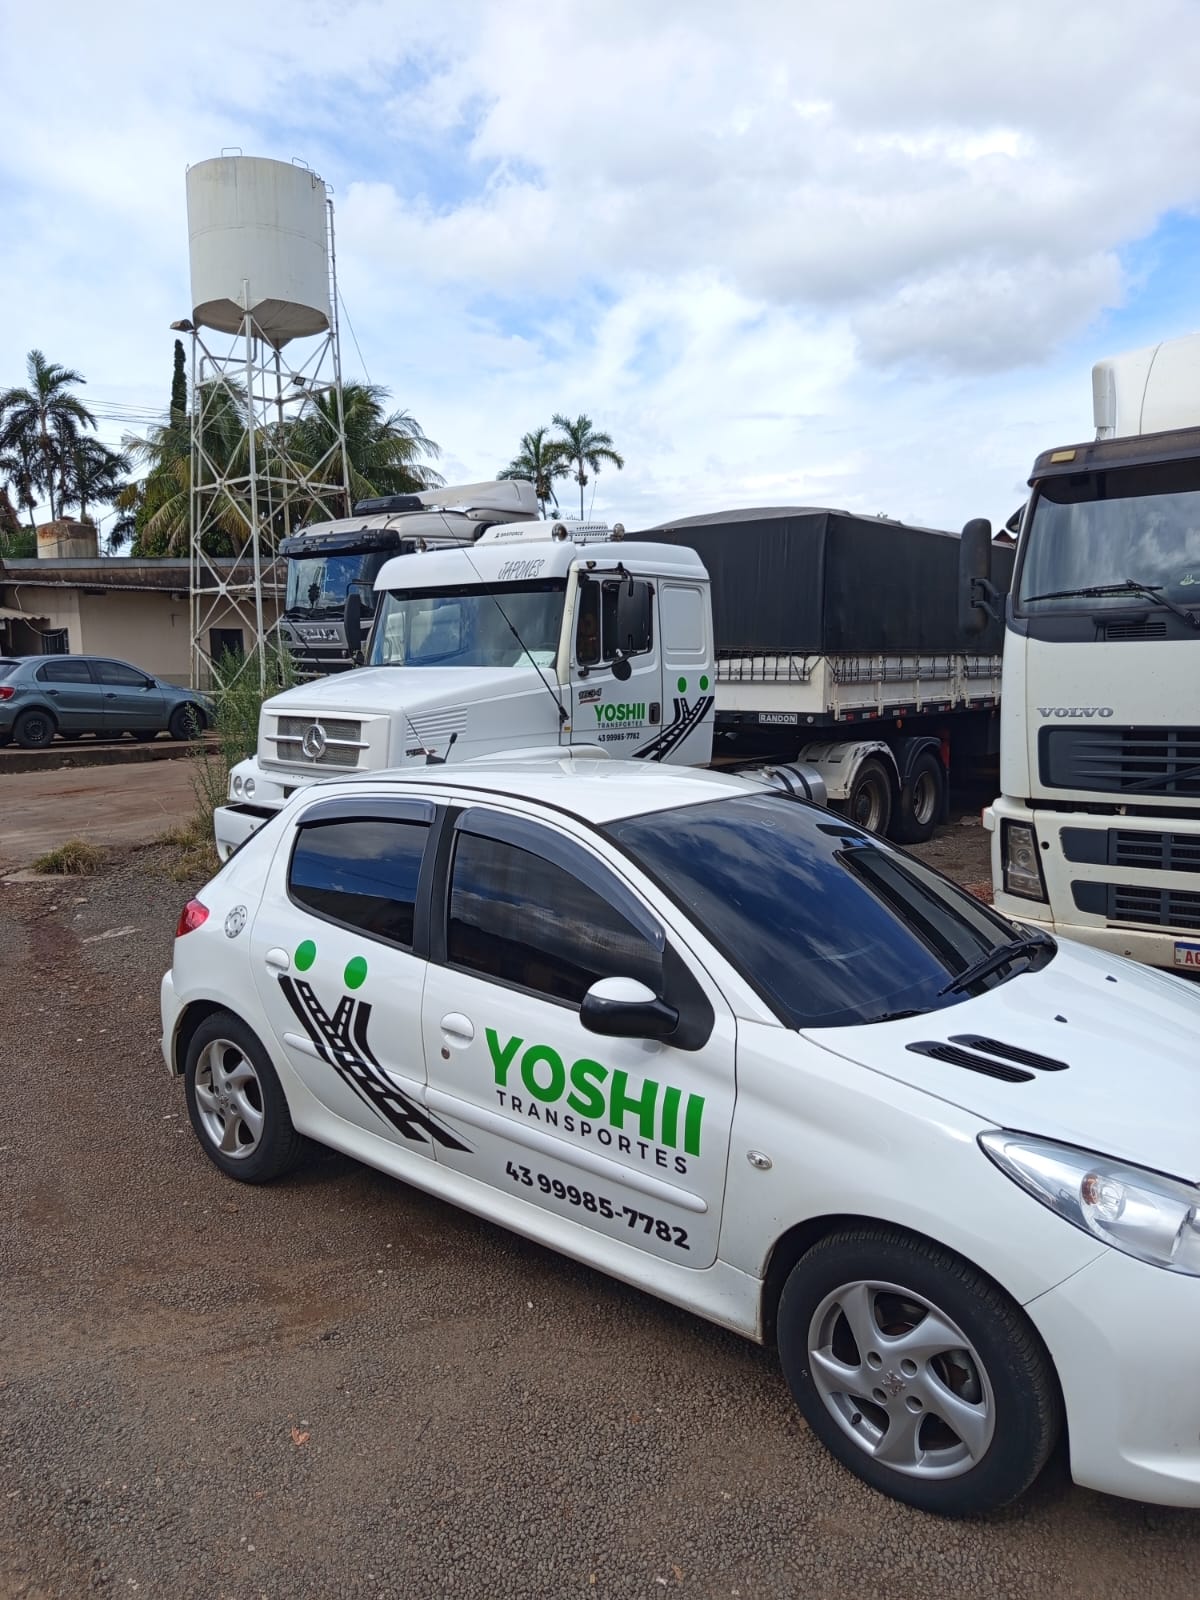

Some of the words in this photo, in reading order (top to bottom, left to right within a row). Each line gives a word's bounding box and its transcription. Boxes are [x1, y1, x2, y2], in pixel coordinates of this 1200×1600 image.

[498, 559, 545, 579] JAPONES
[594, 703, 645, 722] YOSHII
[760, 714, 796, 723] RANDON
[1036, 707, 1114, 718] VOLVO
[598, 721, 643, 729] TRANSPORTES
[598, 734, 606, 742] 43
[485, 1027, 706, 1157] YOSHII
[496, 1090, 688, 1175] TRANSPORTES
[505, 1160, 534, 1187] 43
[537, 1173, 690, 1250] 99985-7782
